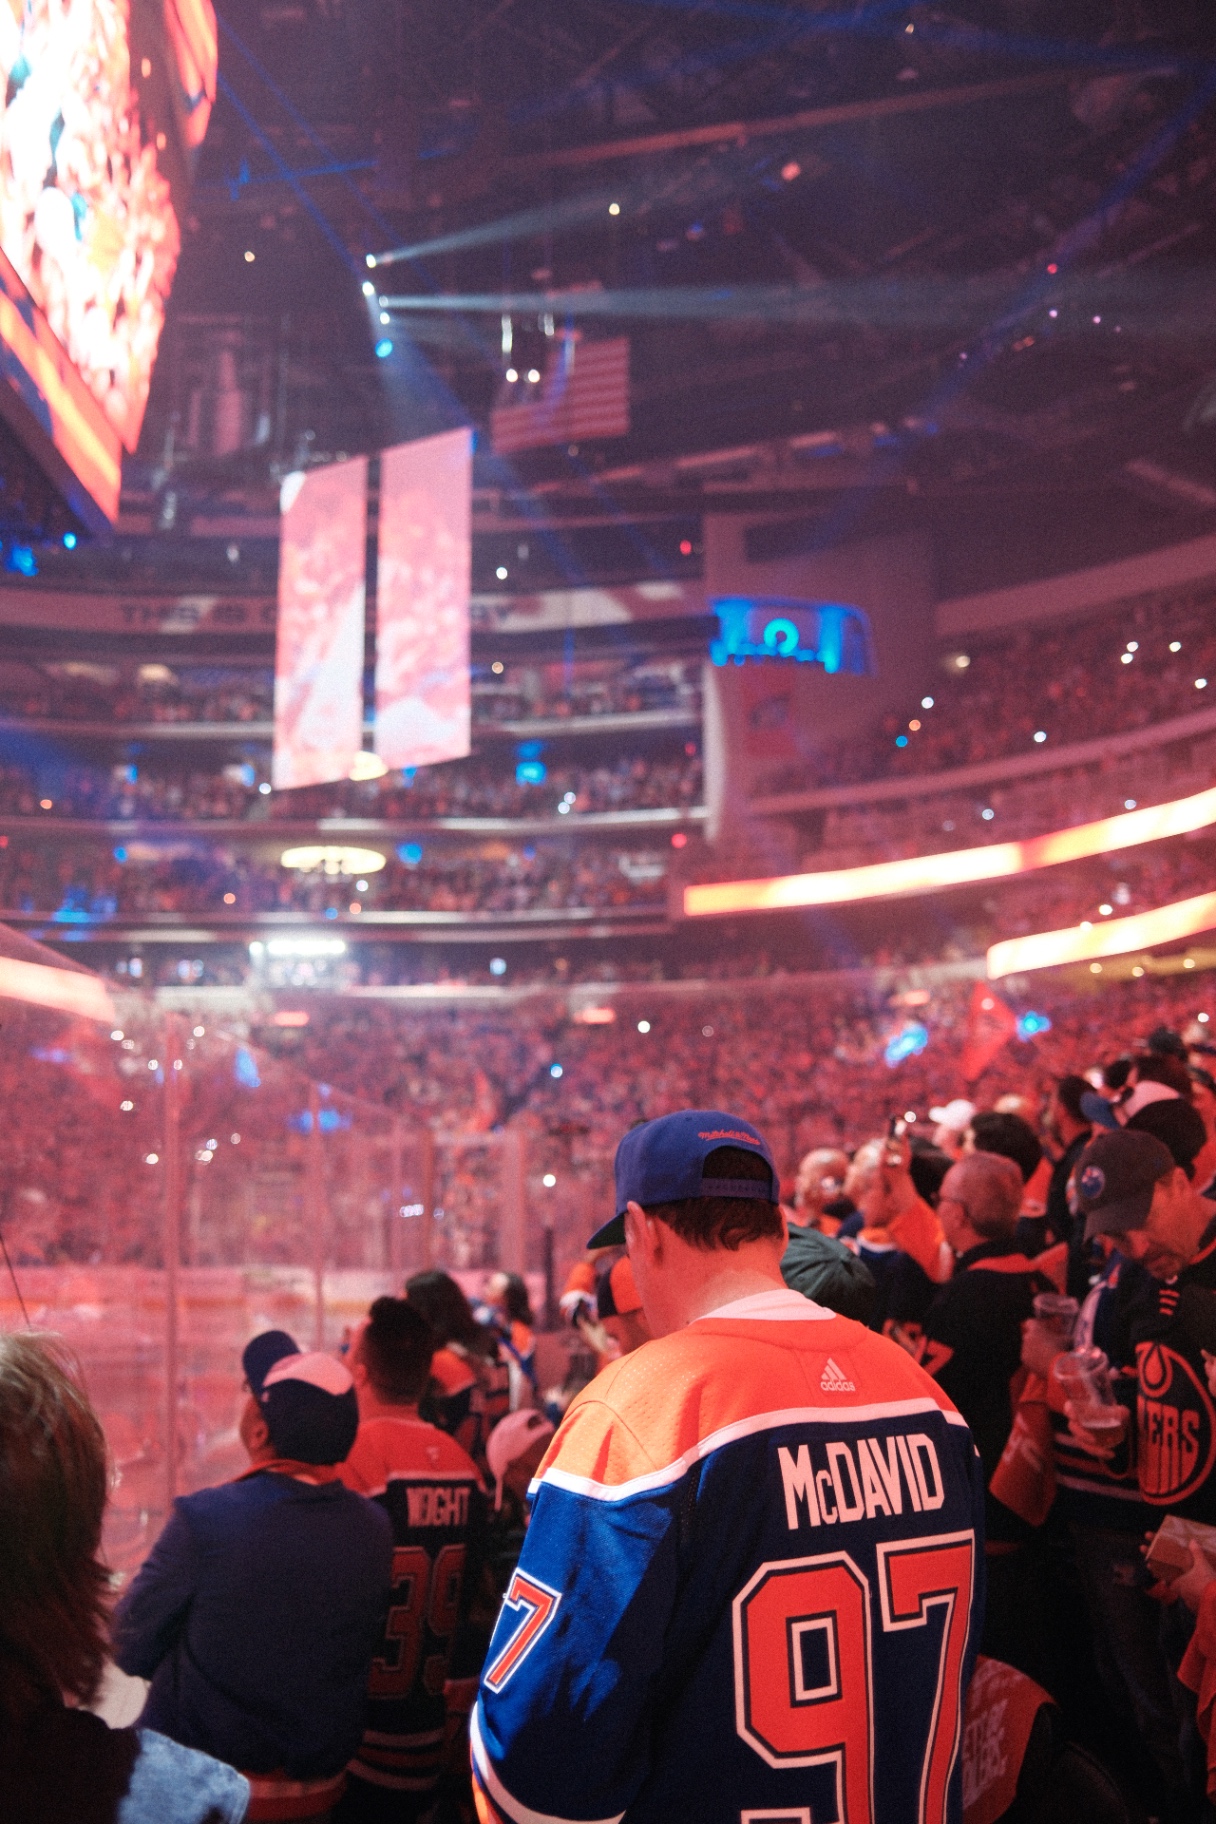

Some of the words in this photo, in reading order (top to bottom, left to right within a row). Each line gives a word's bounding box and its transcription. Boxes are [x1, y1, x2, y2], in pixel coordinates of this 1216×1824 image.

[820, 1379, 856, 1392] adidas
[777, 1433, 945, 1531] McDAVID
[367, 1543, 467, 1700] 39
[732, 1528, 975, 1824] 97
